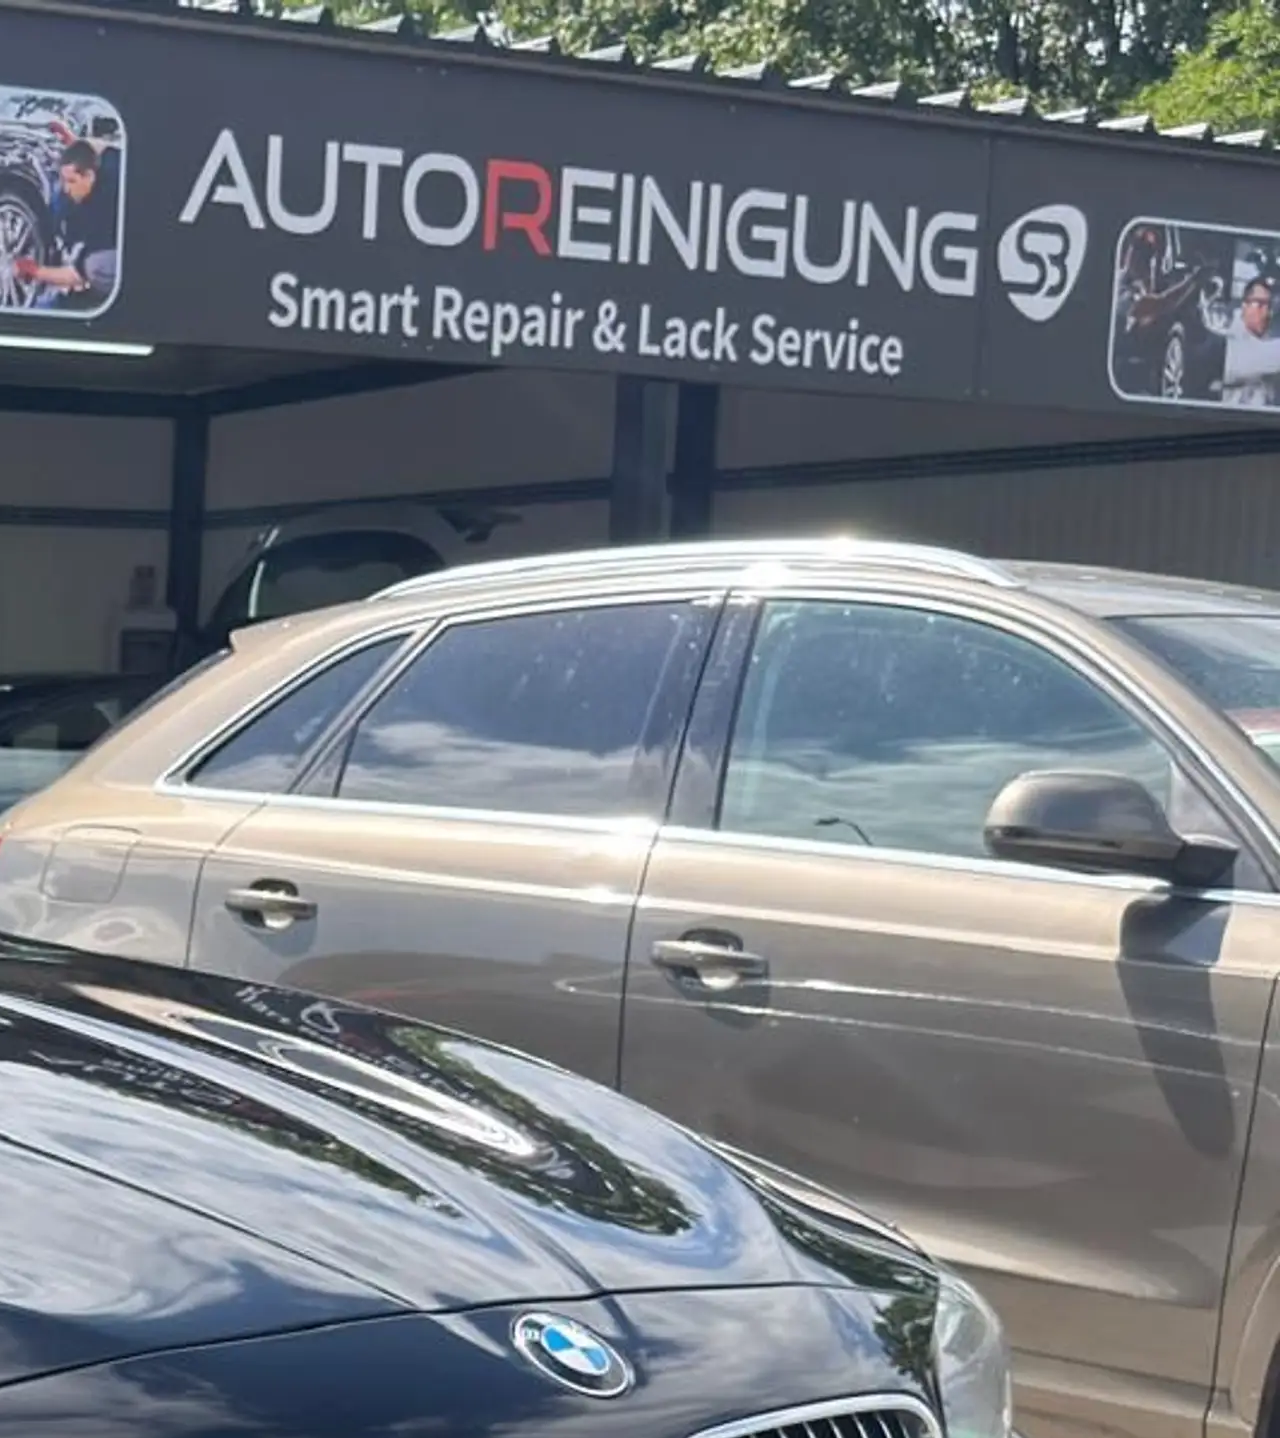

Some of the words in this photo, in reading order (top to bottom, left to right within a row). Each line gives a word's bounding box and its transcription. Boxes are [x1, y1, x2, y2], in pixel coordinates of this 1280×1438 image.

[179, 128, 978, 297] AUTOREINIGUNG
[268, 272, 419, 337] Smart
[432, 285, 585, 357] Repair
[592, 300, 626, 352] &
[638, 303, 739, 362] Lack
[748, 313, 904, 376] Service
